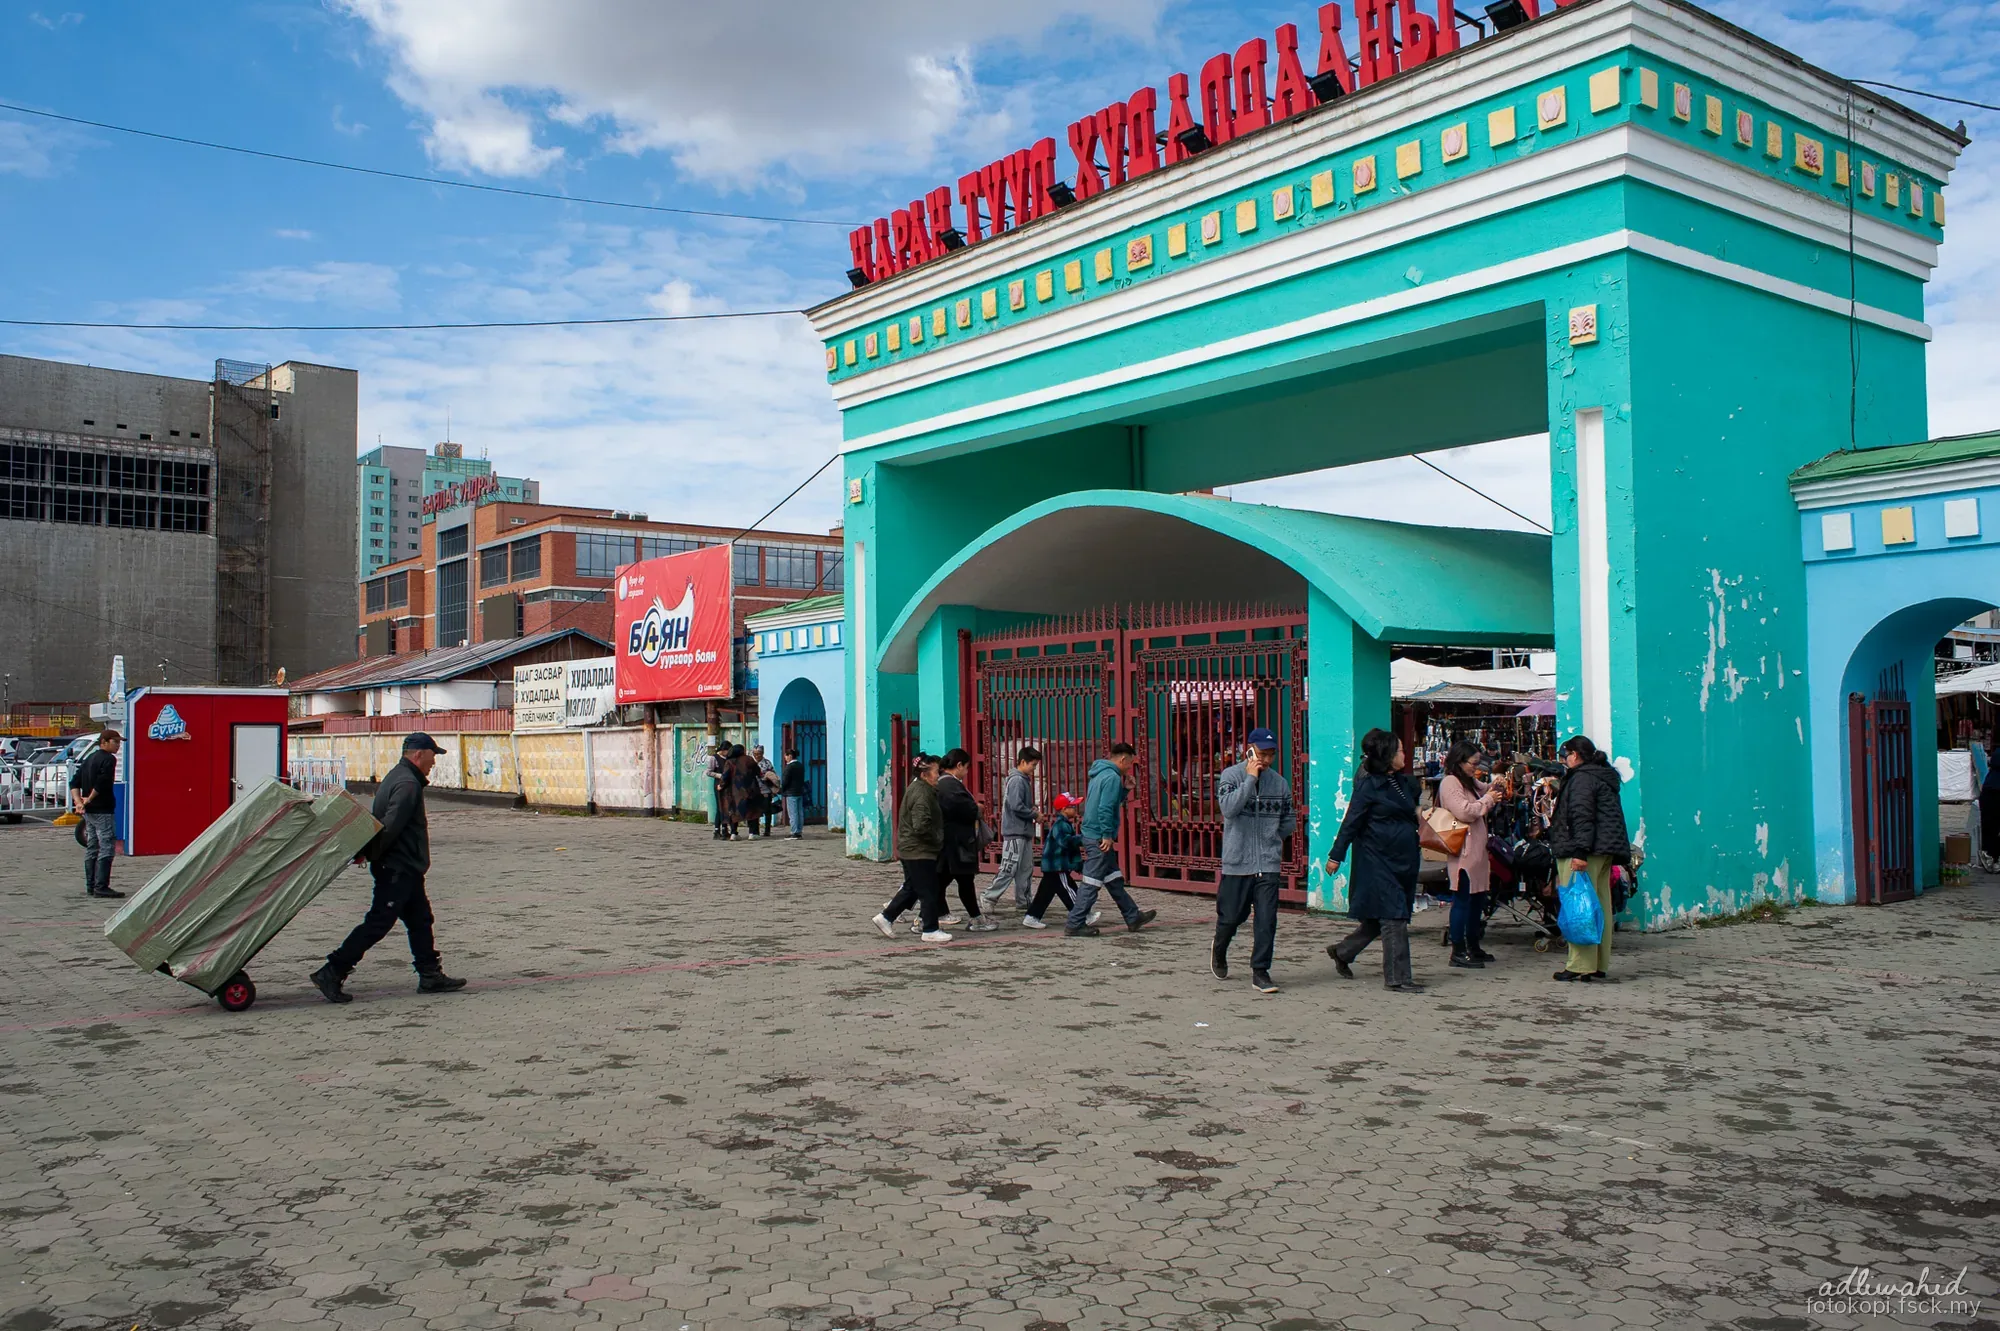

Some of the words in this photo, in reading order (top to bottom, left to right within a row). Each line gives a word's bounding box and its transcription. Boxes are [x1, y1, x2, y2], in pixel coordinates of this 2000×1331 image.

[849, 186, 951, 285] НАРАН
[629, 616, 689, 653] БАЯН
[695, 649, 716, 663] баян
[520, 670, 533, 684] ЦАГ
[534, 666, 562, 681] ЗАСВАР
[571, 667, 615, 690] ХУДАЛДАА
[521, 688, 561, 704] ХУДАЛДАА
